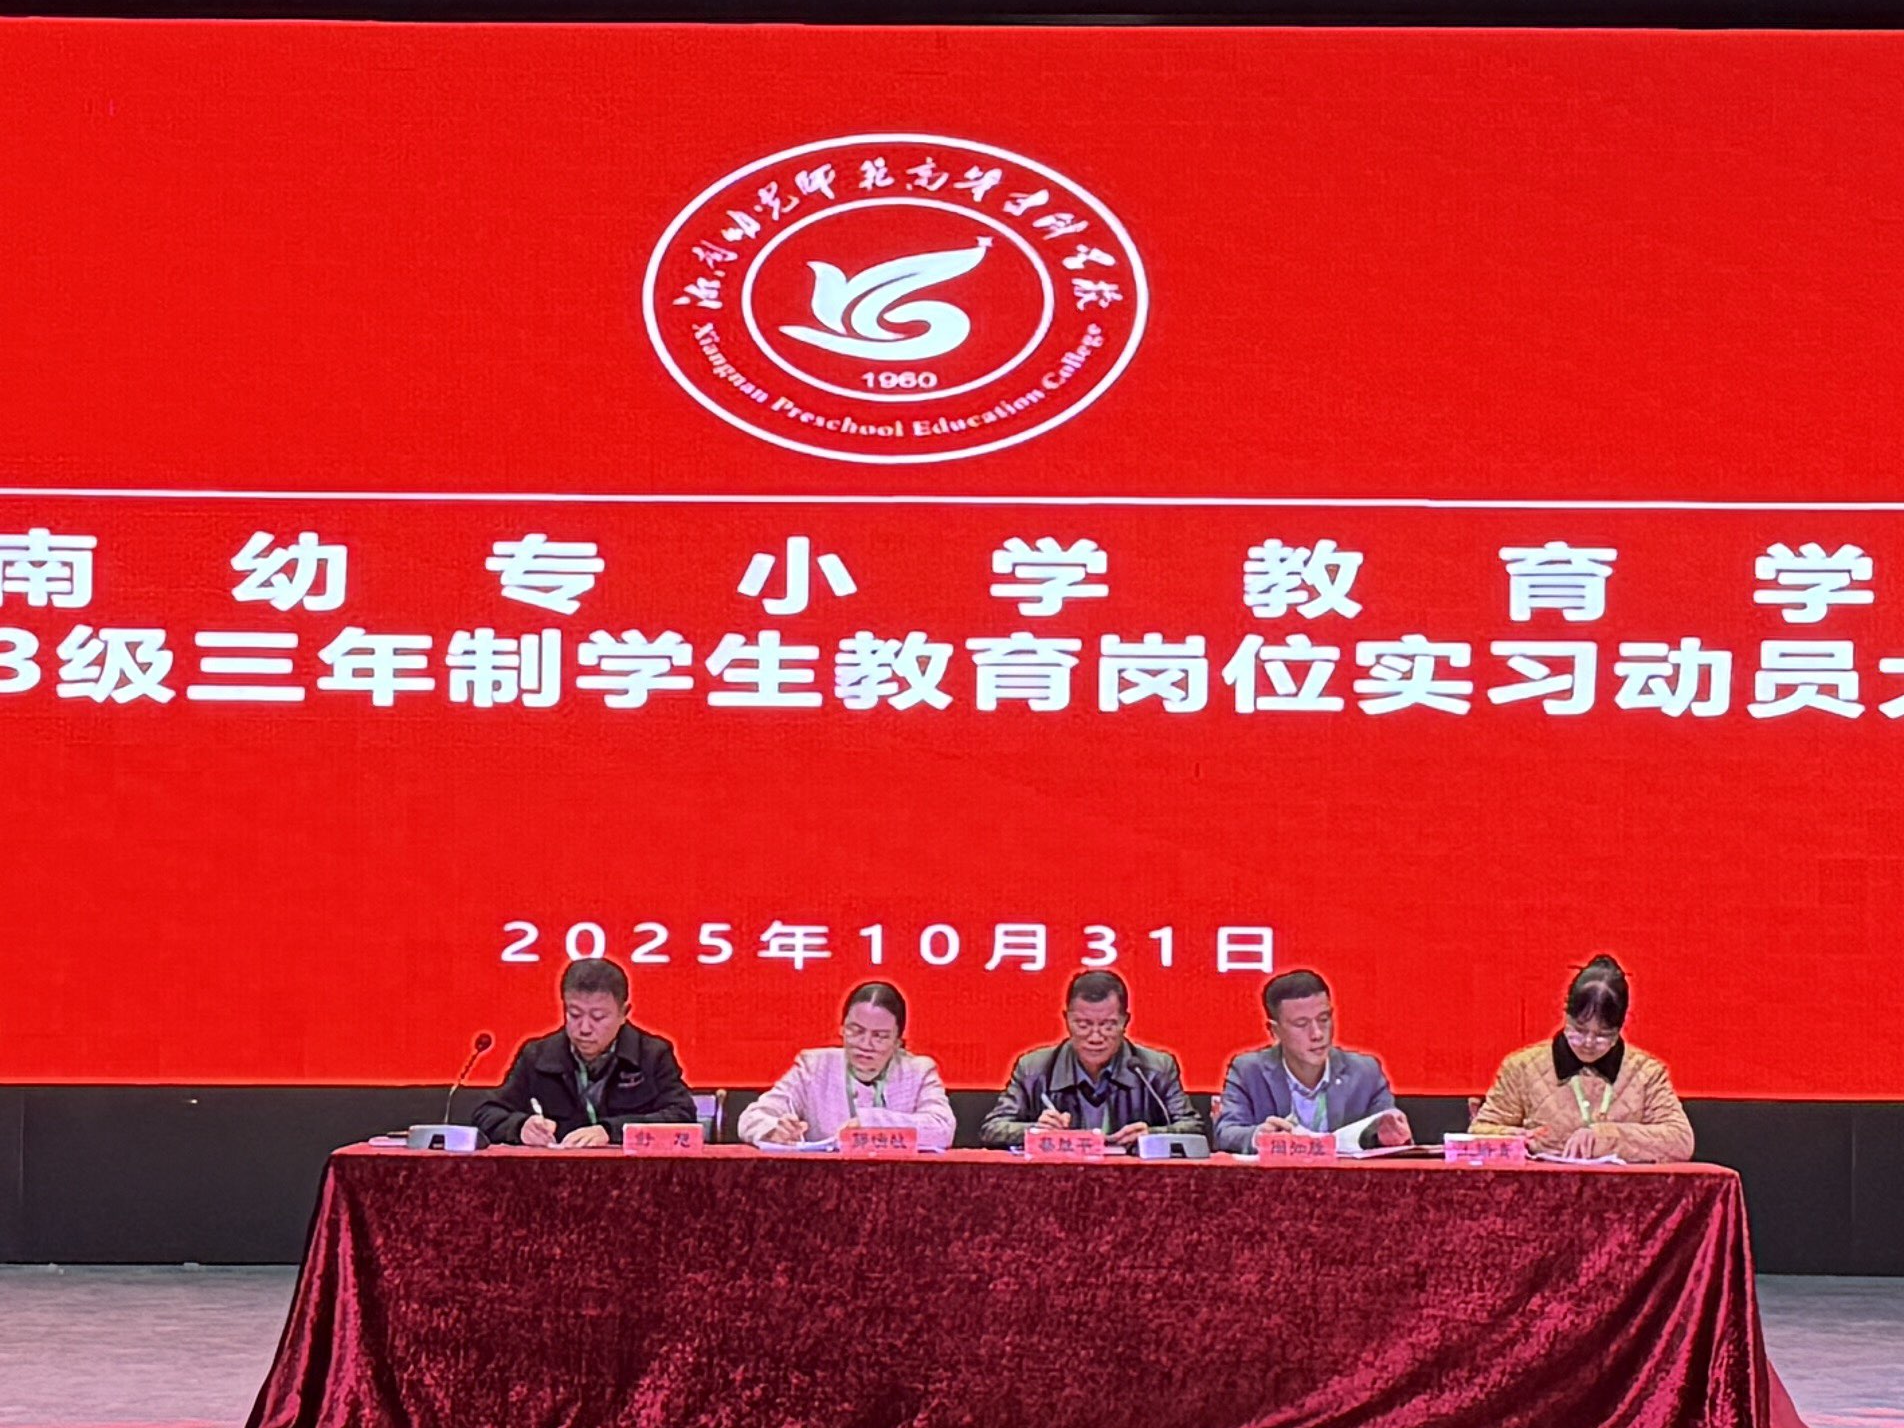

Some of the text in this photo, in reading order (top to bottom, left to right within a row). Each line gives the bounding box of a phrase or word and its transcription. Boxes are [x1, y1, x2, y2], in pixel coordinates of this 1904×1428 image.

[771, 395, 905, 439] Preschool
[913, 387, 1043, 439] Education
[1039, 322, 1104, 395] College
[862, 371, 938, 389] 1960
[501, 919, 1275, 975] 2025年10月31日
